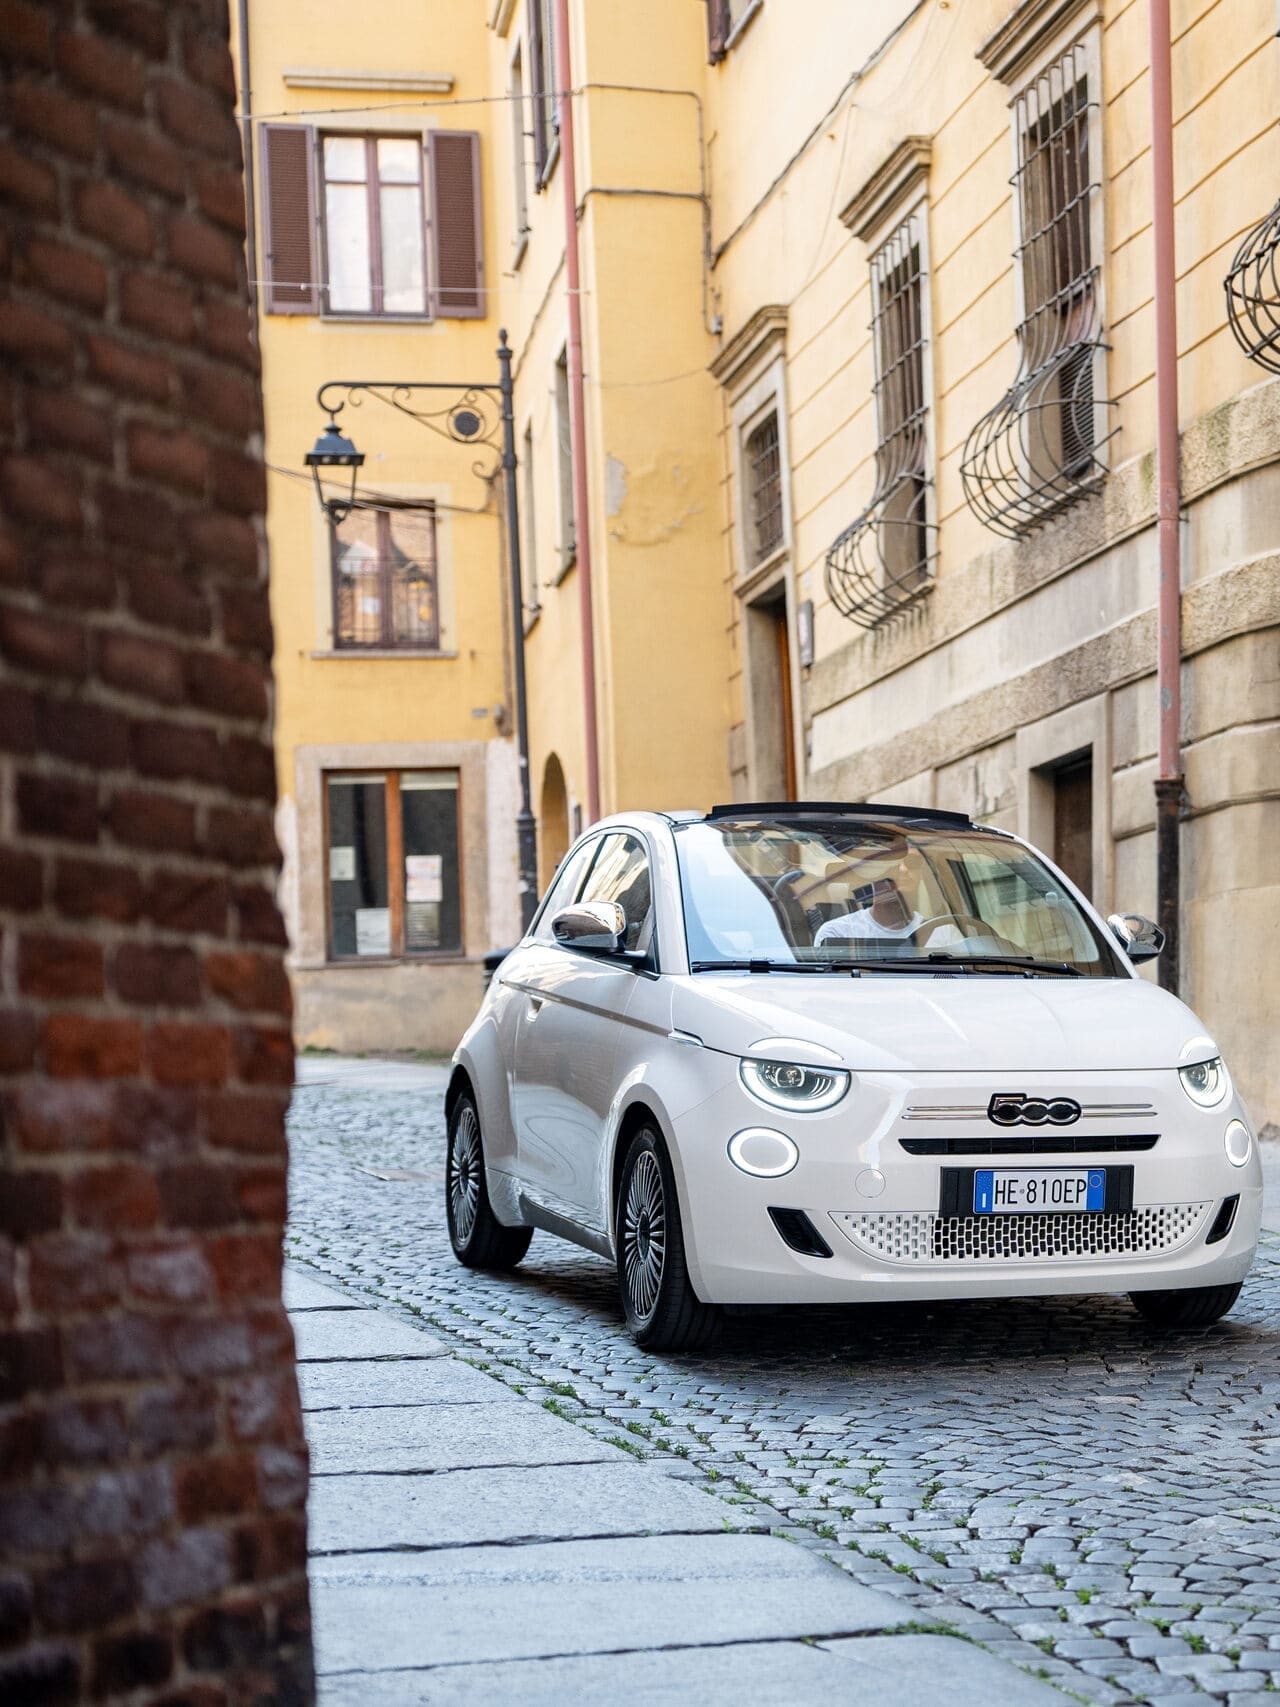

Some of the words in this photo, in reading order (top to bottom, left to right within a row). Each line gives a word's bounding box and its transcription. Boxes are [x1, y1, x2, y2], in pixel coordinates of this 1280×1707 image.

[990, 1095, 1080, 1125] 500
[994, 1179, 1019, 1205] HE
[1026, 1178, 1087, 1204] 810EP
